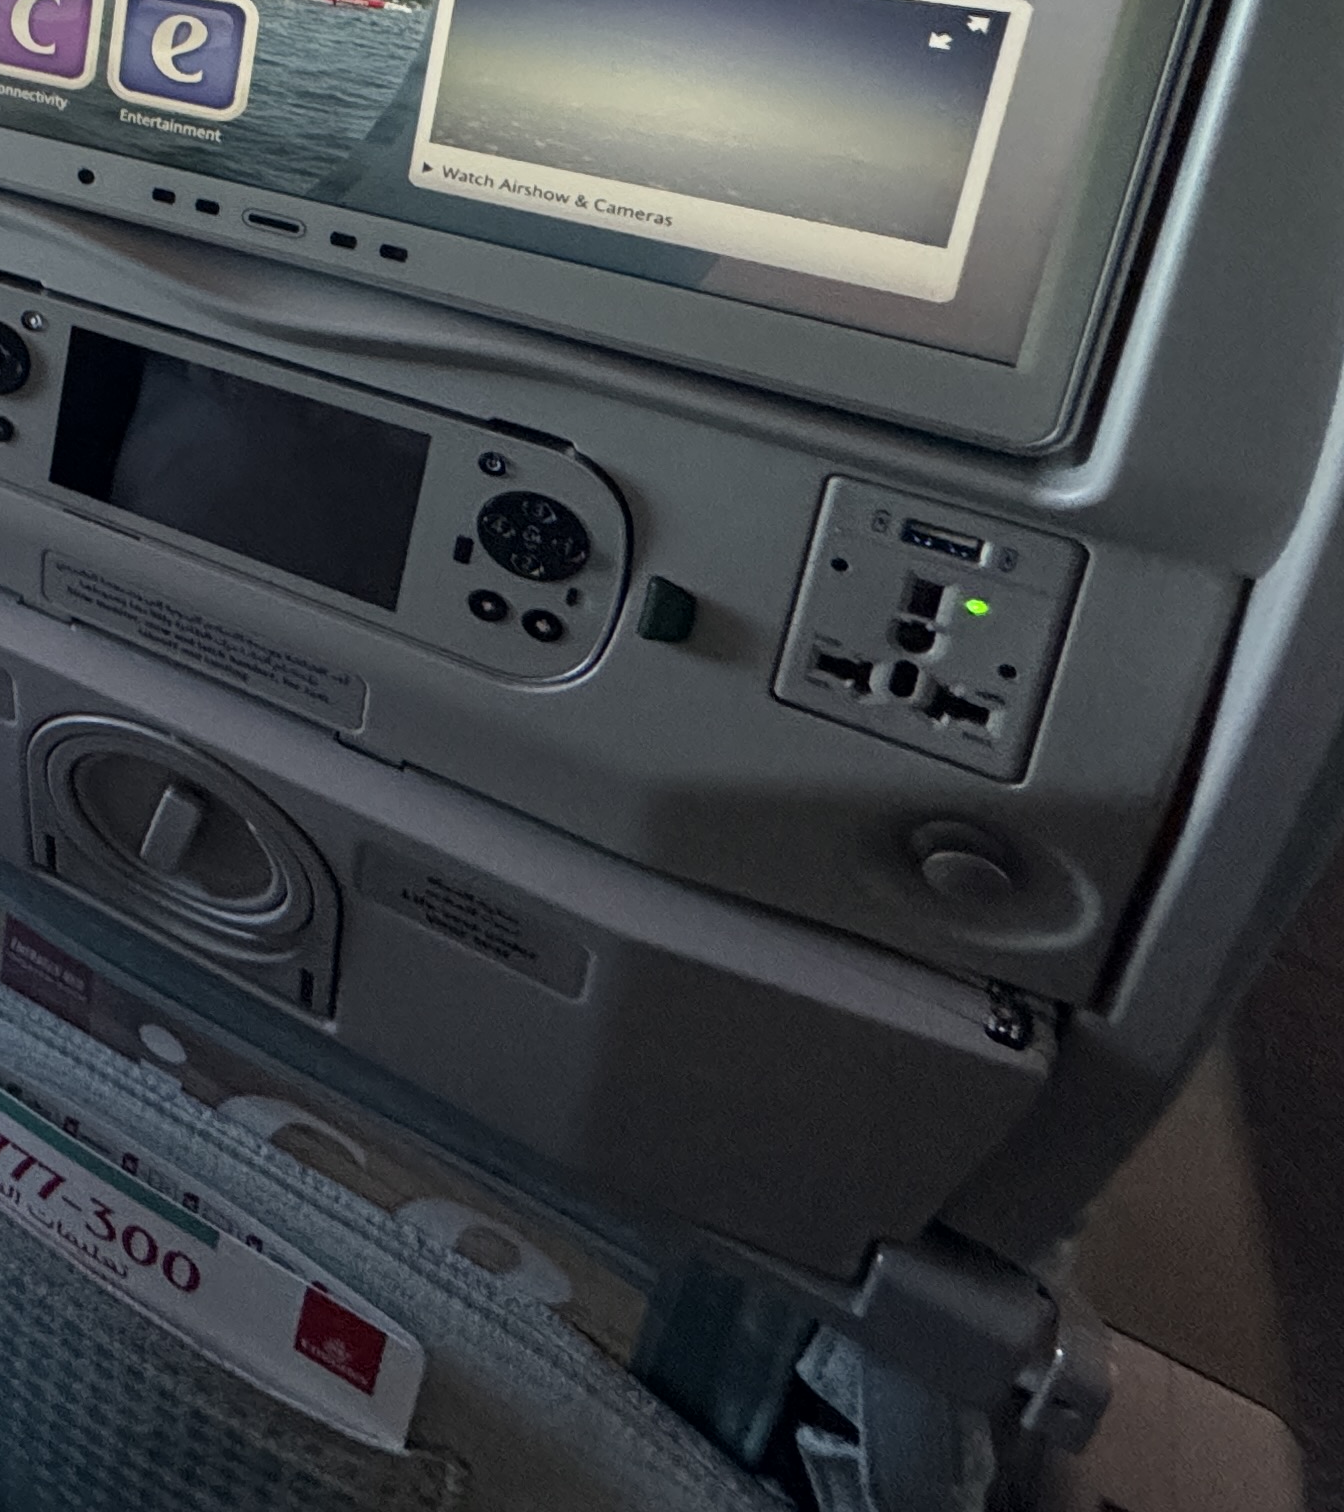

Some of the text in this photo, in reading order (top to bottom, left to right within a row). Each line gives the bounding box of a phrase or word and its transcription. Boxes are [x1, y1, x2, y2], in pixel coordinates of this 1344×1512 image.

[150, 14, 209, 84] e
[119, 108, 222, 143] Entertainment
[442, 164, 674, 227] Watch Airshow & Cameras
